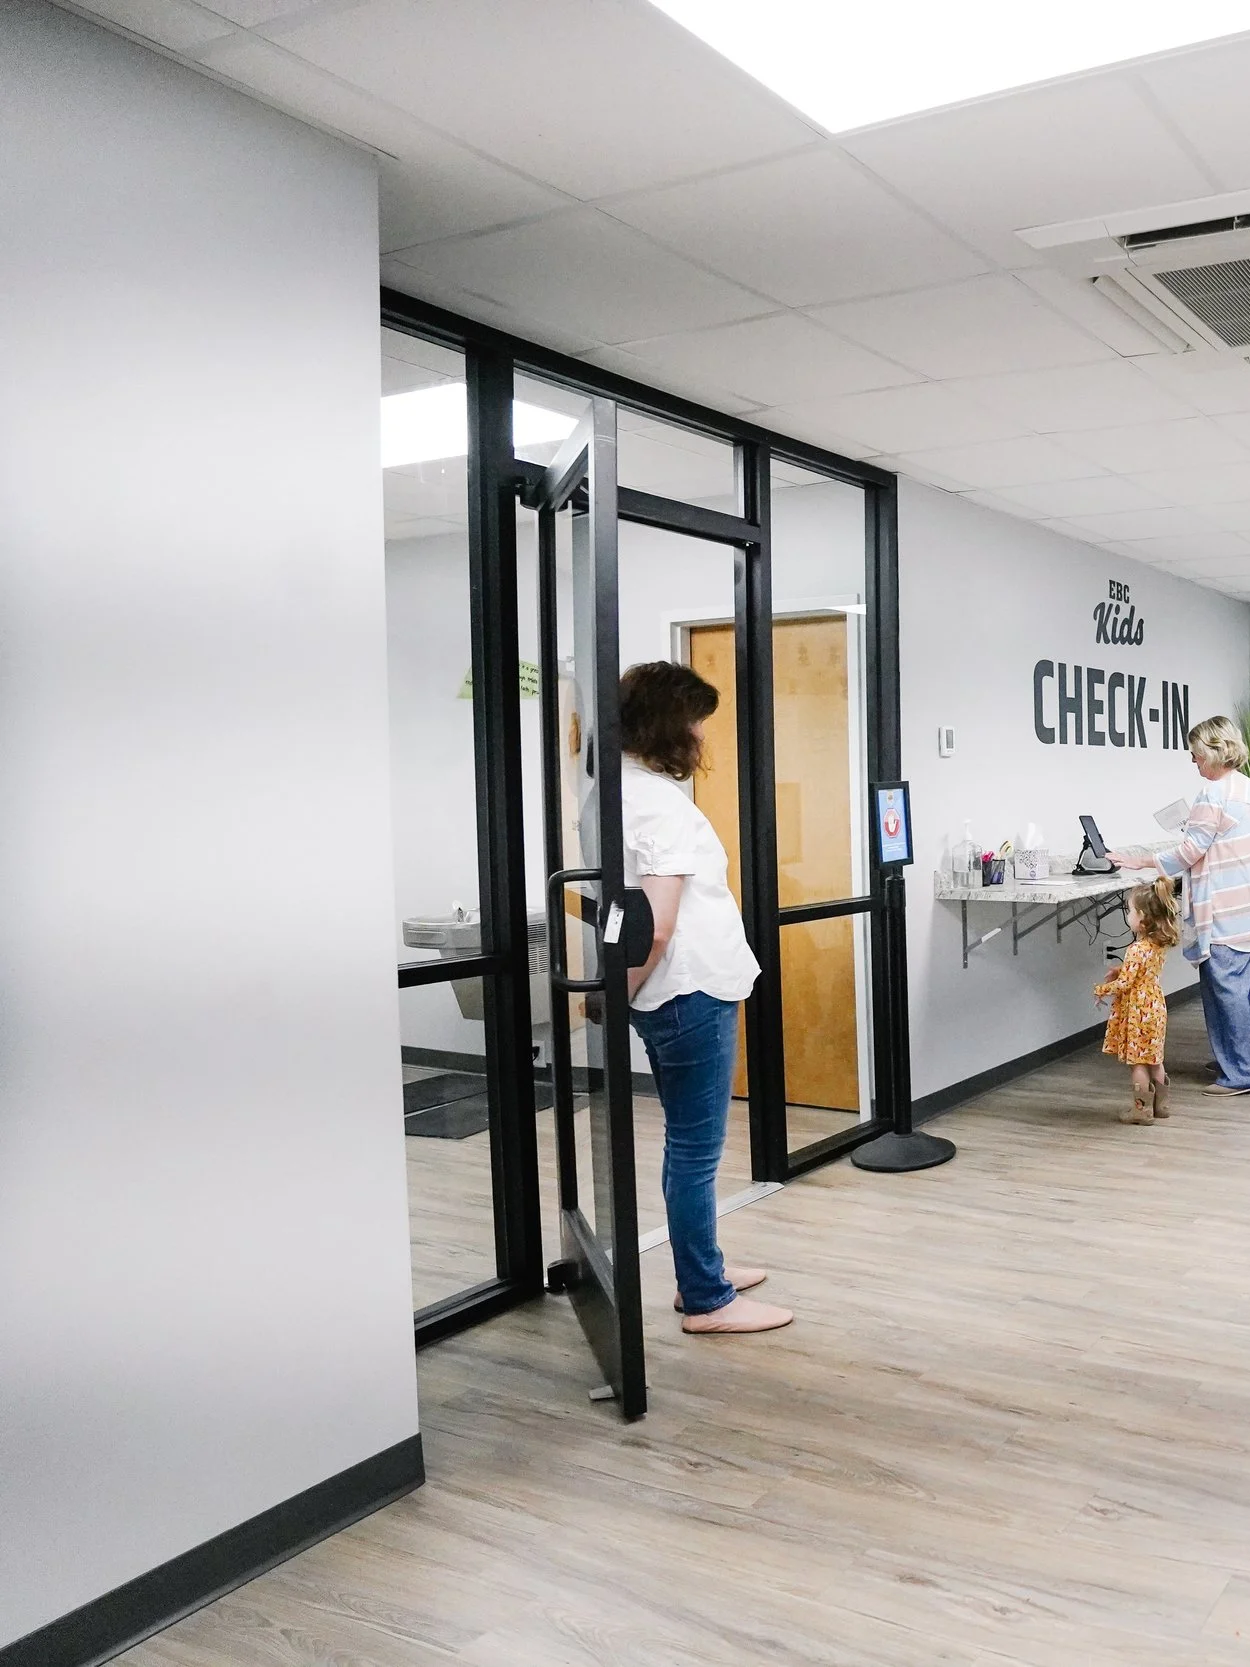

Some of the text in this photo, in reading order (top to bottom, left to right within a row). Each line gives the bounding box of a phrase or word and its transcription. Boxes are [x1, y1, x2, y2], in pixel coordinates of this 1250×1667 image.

[1108, 579, 1130, 604] EBC
[1093, 601, 1144, 646] Kids
[1033, 659, 1189, 751] CHECK-IN
